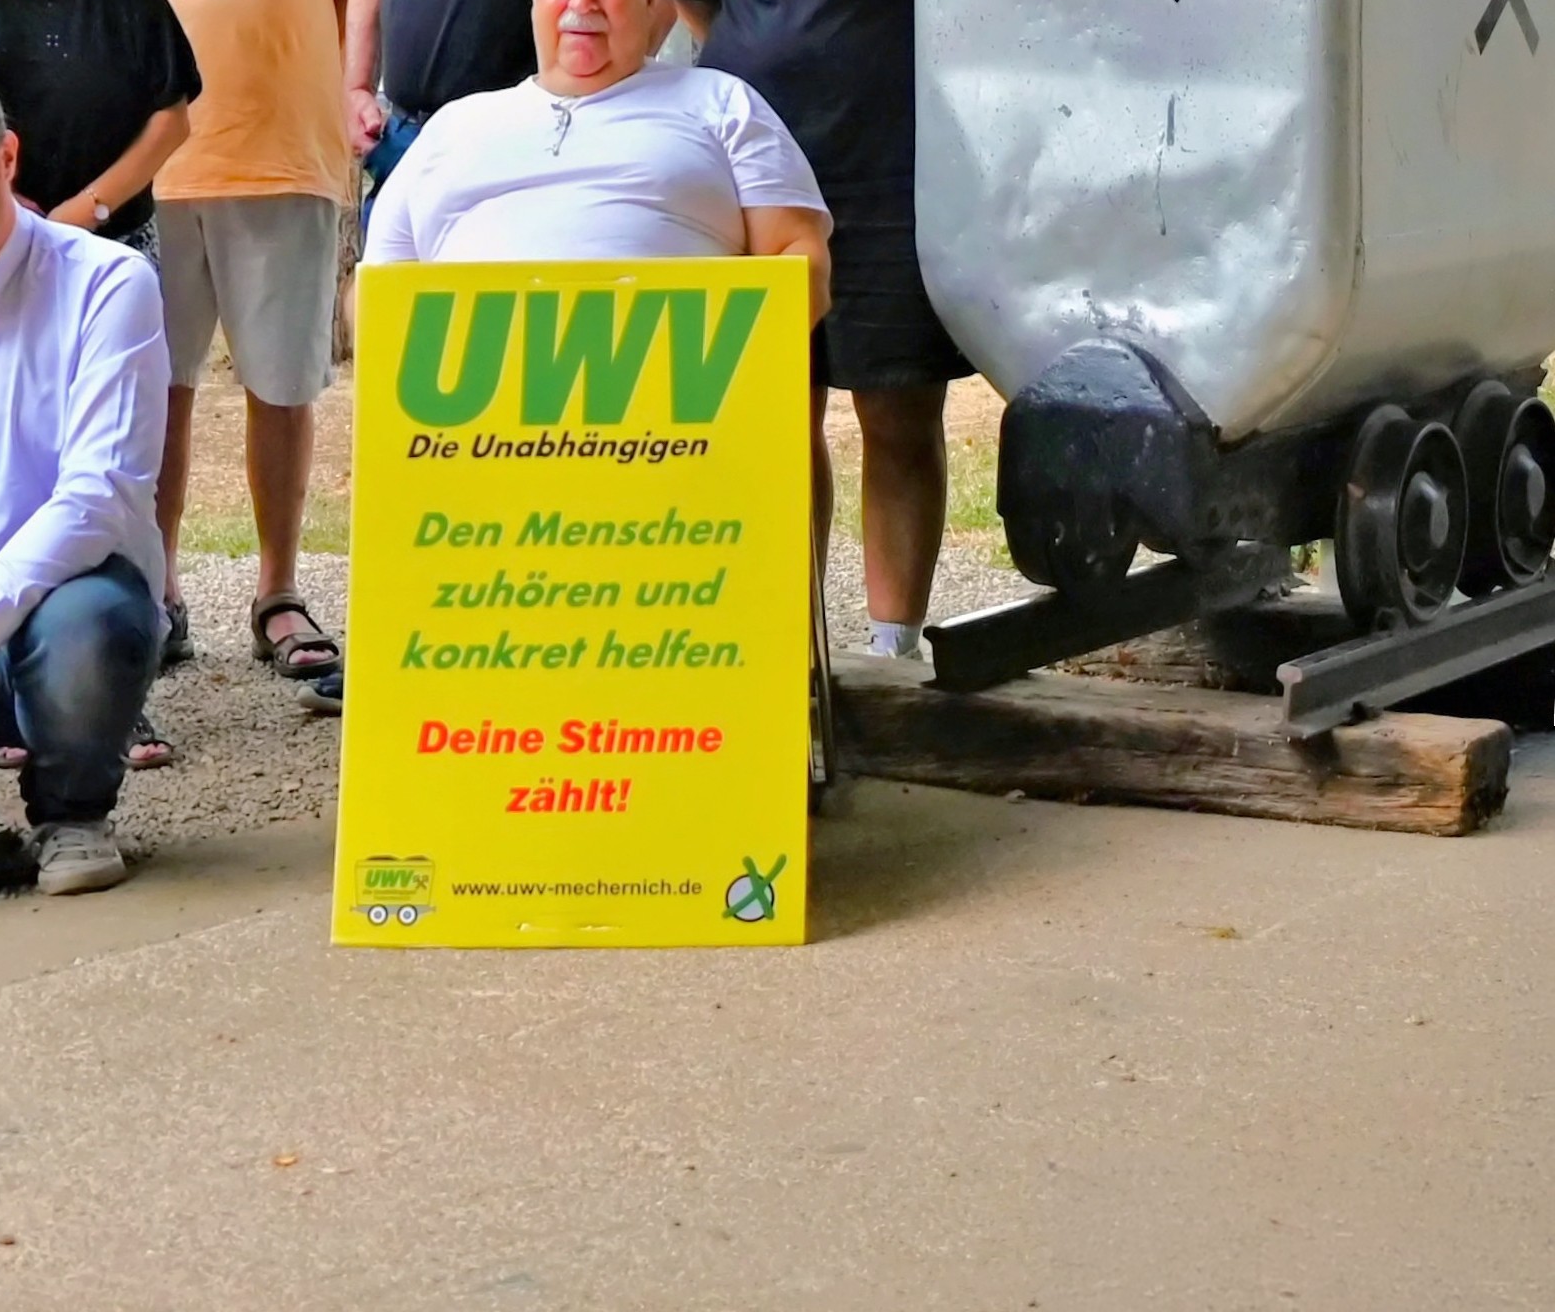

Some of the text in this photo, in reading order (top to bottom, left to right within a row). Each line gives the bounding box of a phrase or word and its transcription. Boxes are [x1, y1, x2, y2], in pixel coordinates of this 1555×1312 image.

[396, 288, 768, 428] UWV
[407, 431, 708, 464] Die Unabhängigen
[413, 507, 742, 548] Den Menschen
[431, 567, 726, 608] zuhören und
[400, 628, 745, 670] konkret helfen.
[417, 719, 723, 754] Deine Stimme
[505, 777, 632, 813] zählt!
[365, 869, 414, 888] UWV
[451, 879, 702, 897] www.uwv-mechernich.de
